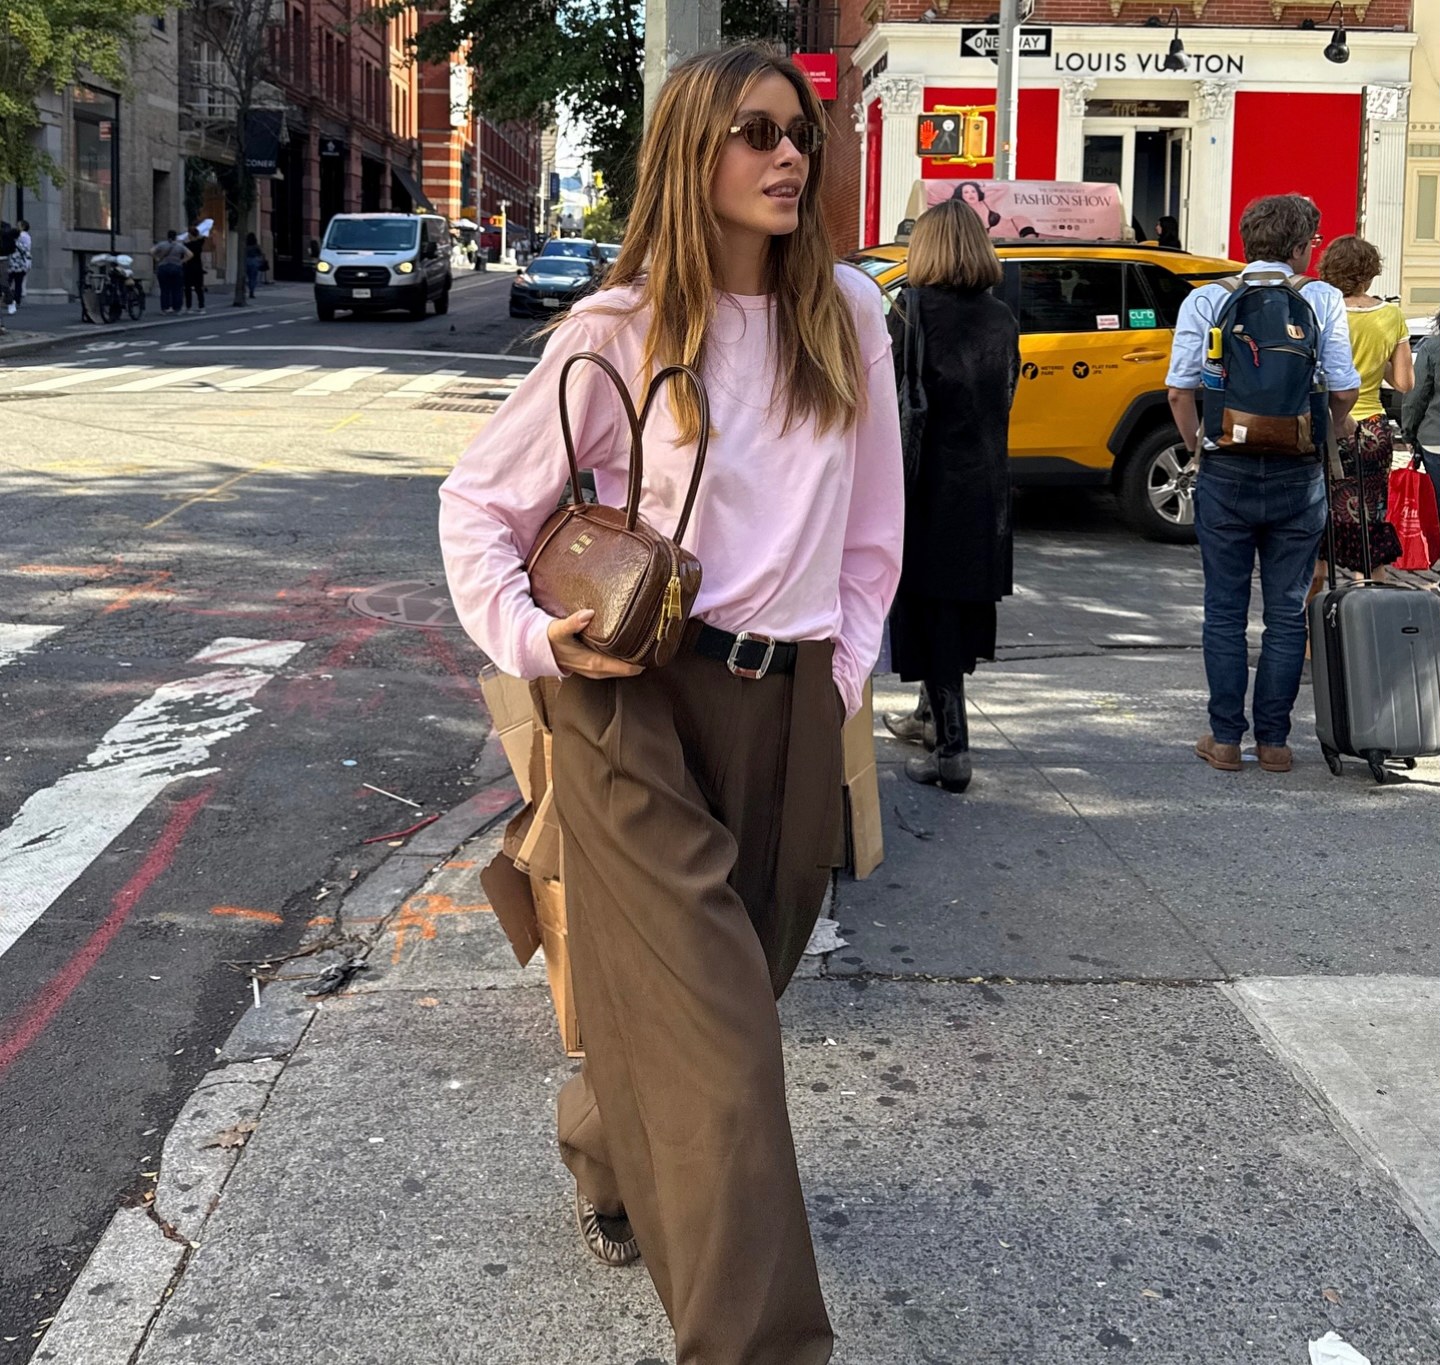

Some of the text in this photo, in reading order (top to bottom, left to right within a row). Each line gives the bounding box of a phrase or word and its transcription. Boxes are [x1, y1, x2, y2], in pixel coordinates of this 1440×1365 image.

[974, 37, 1040, 49] ONE AY
[1055, 53, 1244, 74] LOUIS VUTON
[1014, 193, 1112, 207] FASHION SHOW
[1129, 309, 1155, 320] curb
